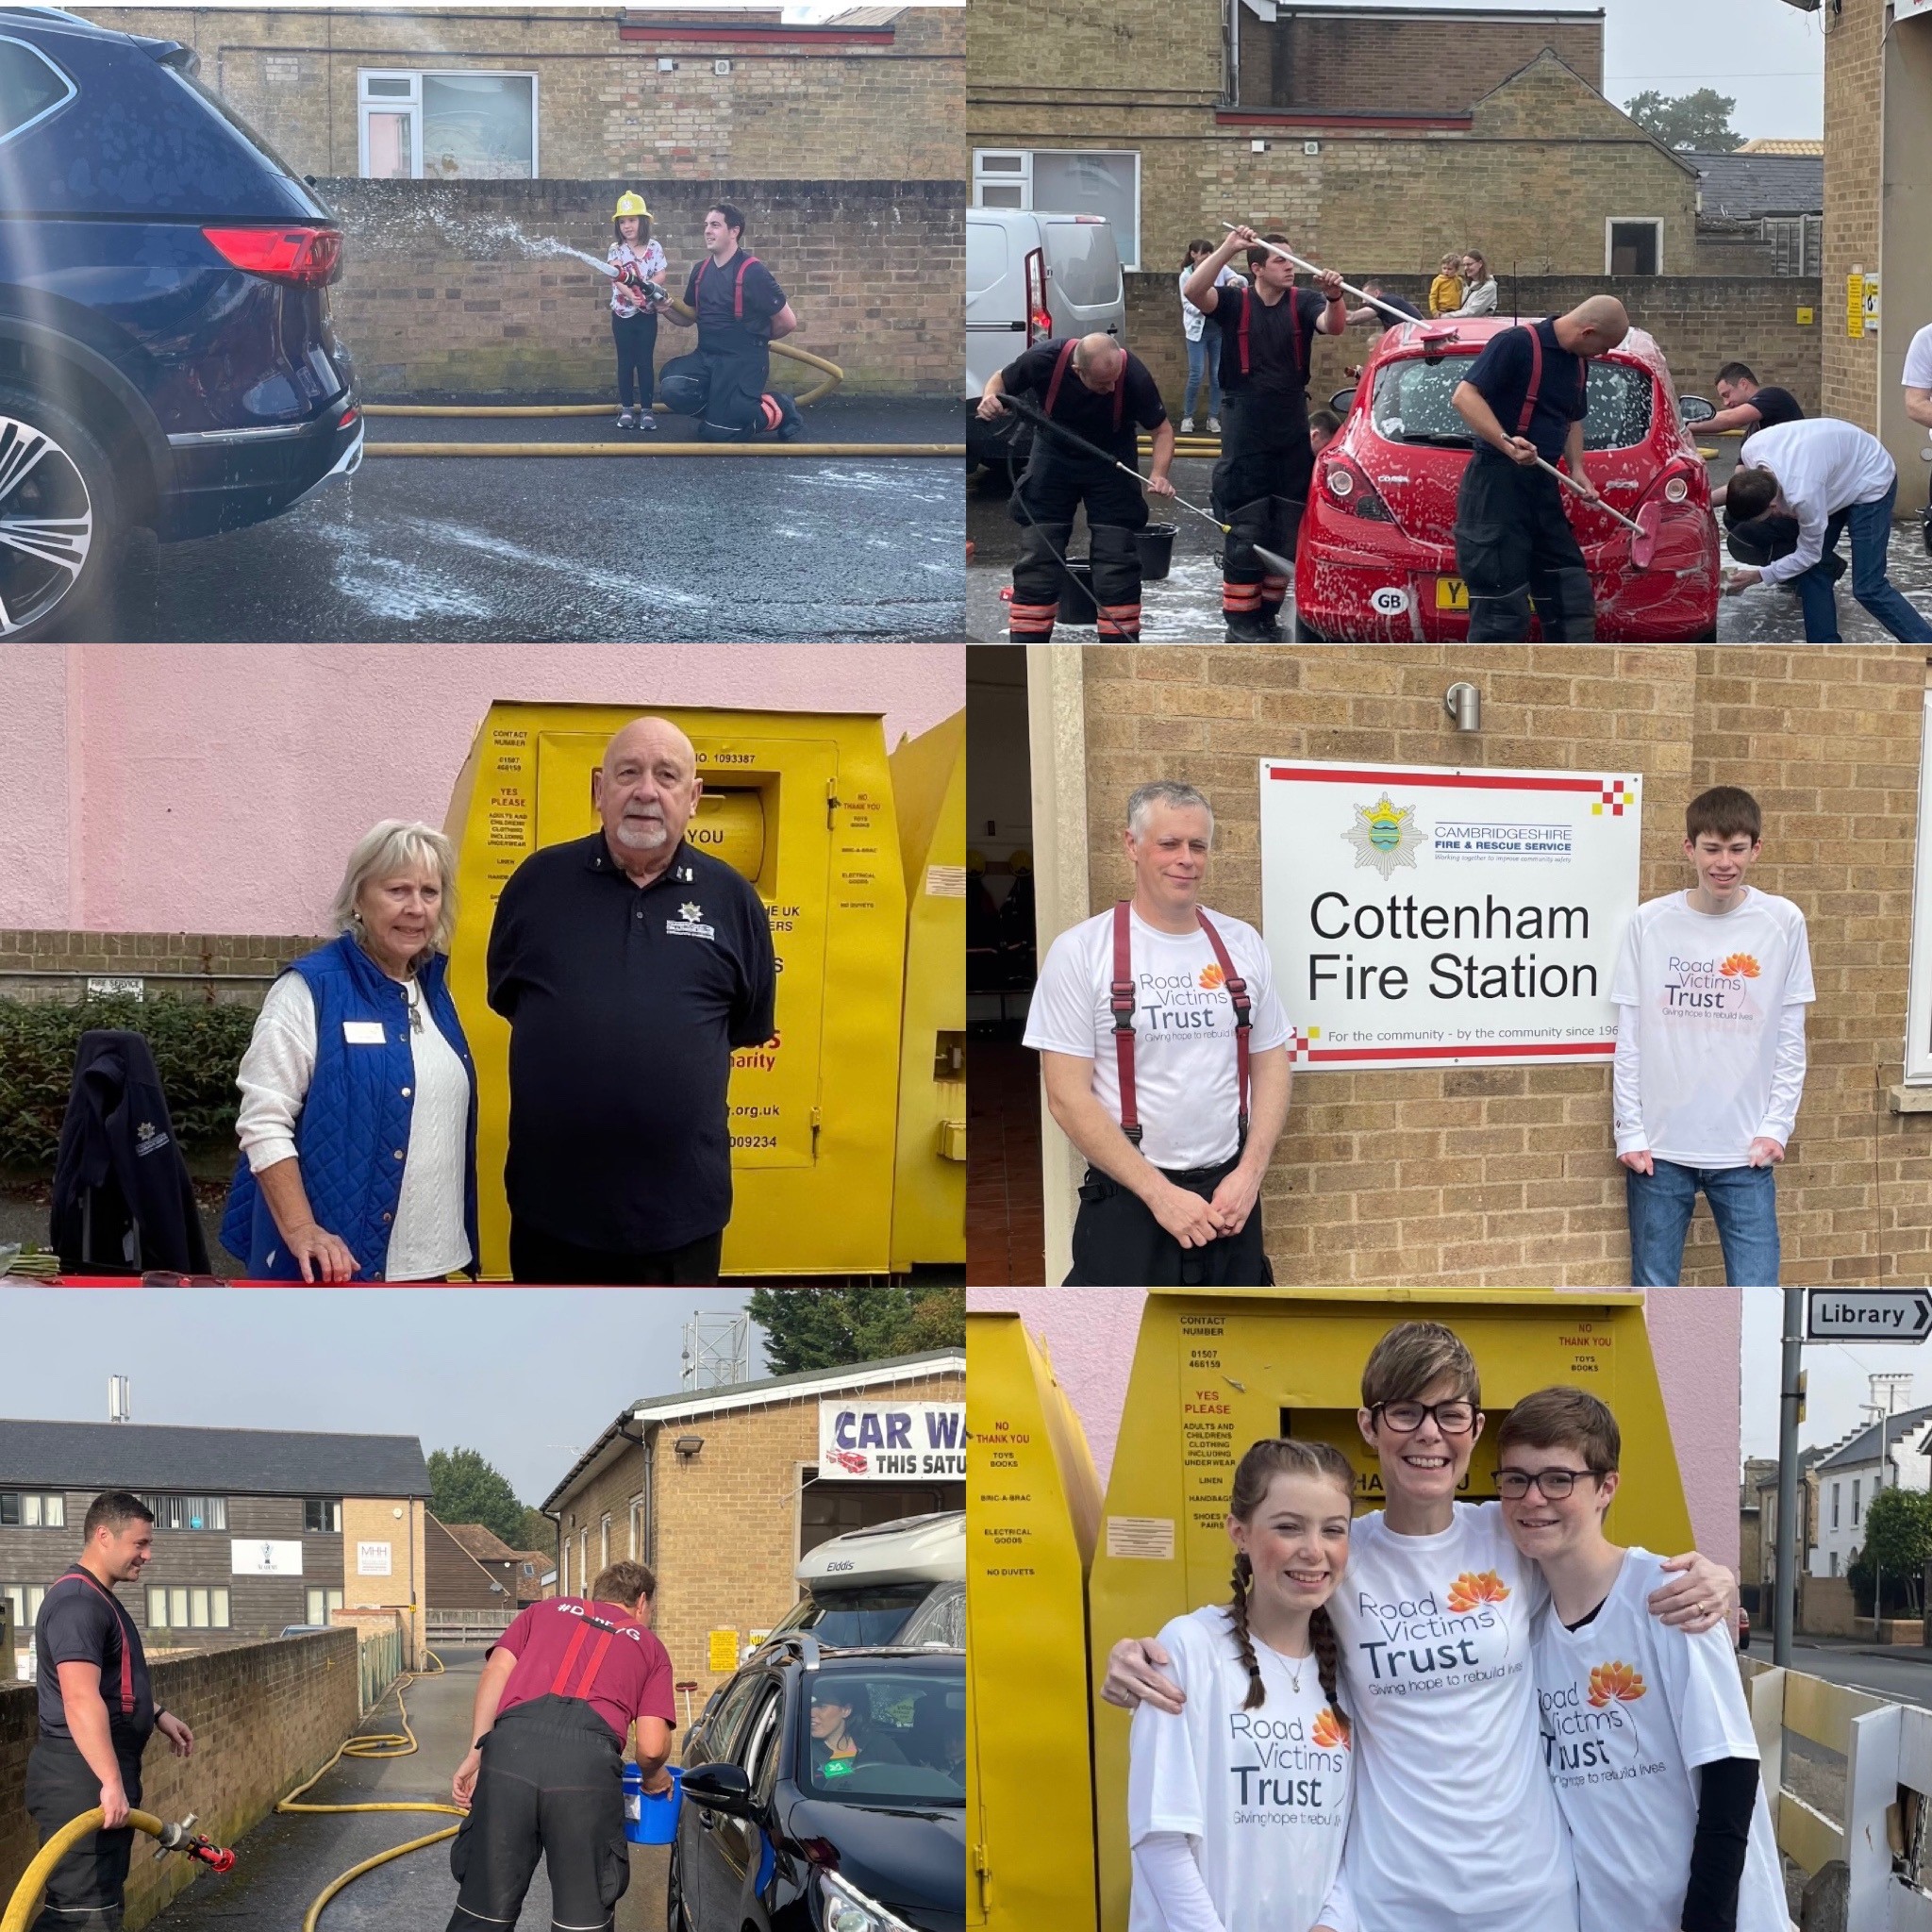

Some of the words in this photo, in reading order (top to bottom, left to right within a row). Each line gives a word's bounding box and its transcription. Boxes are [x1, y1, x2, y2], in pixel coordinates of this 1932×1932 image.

[1378, 594, 1401, 608] GB
[714, 754, 756, 763] 1093387
[491, 798, 526, 807] PLEASE
[687, 829, 724, 843] YOU
[1435, 826, 1572, 840] CAMBRIDGESHIRE
[1435, 841, 1461, 849] FIRE
[1475, 841, 1521, 850] RESCUE
[1524, 842, 1572, 851] SERVICE
[1435, 854, 1460, 862] Working
[783, 906, 800, 917] UK
[1309, 891, 1589, 940] Cottenham
[1669, 957, 1714, 974] Road
[1140, 973, 1193, 991] Road
[1309, 954, 1408, 1001] Fire
[1428, 953, 1598, 1000] Station
[1679, 972, 1741, 991] Victims
[1156, 989, 1228, 1006] Victims
[1664, 985, 1724, 1008] Trust
[1141, 1005, 1215, 1030] Trust
[1662, 1008, 1683, 1018] Giving
[1685, 1008, 1703, 1019] hope
[1704, 1009, 1711, 1018] to
[1713, 1010, 1738, 1021] rebuild
[1145, 1033, 1171, 1042] Giving
[1172, 1031, 1192, 1041] hope
[1194, 1030, 1202, 1040] to
[1204, 1028, 1230, 1039] rebuild
[1328, 1031, 1349, 1041] For
[1353, 1030, 1373, 1041] the
[1377, 1029, 1444, 1042] community
[1457, 1028, 1472, 1041] by
[1475, 1028, 1495, 1039] the
[1498, 1026, 1562, 1040] community
[1565, 1026, 1594, 1037] since
[728, 1105, 780, 1119] .org.uk
[1821, 1304, 1906, 1328] Library
[1183, 1327, 1224, 1336] NUMBER
[1579, 1324, 1592, 1333] NO
[1558, 1337, 1590, 1346] THANK
[1592, 1338, 1611, 1347] YOU
[1191, 1350, 1218, 1358] 01507
[1196, 1391, 1220, 1400] YES
[1185, 1404, 1231, 1415] PLEASE
[835, 1411, 913, 1449] CAR
[995, 1422, 1009, 1430] NO
[976, 1434, 1008, 1443] THANK
[1010, 1434, 1030, 1443] YOU
[875, 1455, 917, 1474] THIS
[361, 1546, 387, 1557] MHH
[826, 1561, 855, 1572] Elddis
[1358, 1591, 1439, 1620] Road
[1380, 1611, 1495, 1642] Victims
[1359, 1639, 1479, 1679] Trust
[1368, 1683, 1407, 1696] Giving
[1407, 1677, 1443, 1692] hope
[1447, 1674, 1460, 1686] to
[1463, 1665, 1506, 1684] rebuild
[1229, 1713, 1304, 1741] Road
[1254, 1741, 1343, 1773] Victims
[1588, 1773, 1599, 1784] to
[1640, 1762, 1666, 1775] lives
[1230, 1766, 1322, 1807] Trust
[1233, 1810, 1266, 1826] Giving
[1266, 1811, 1298, 1826] hope
